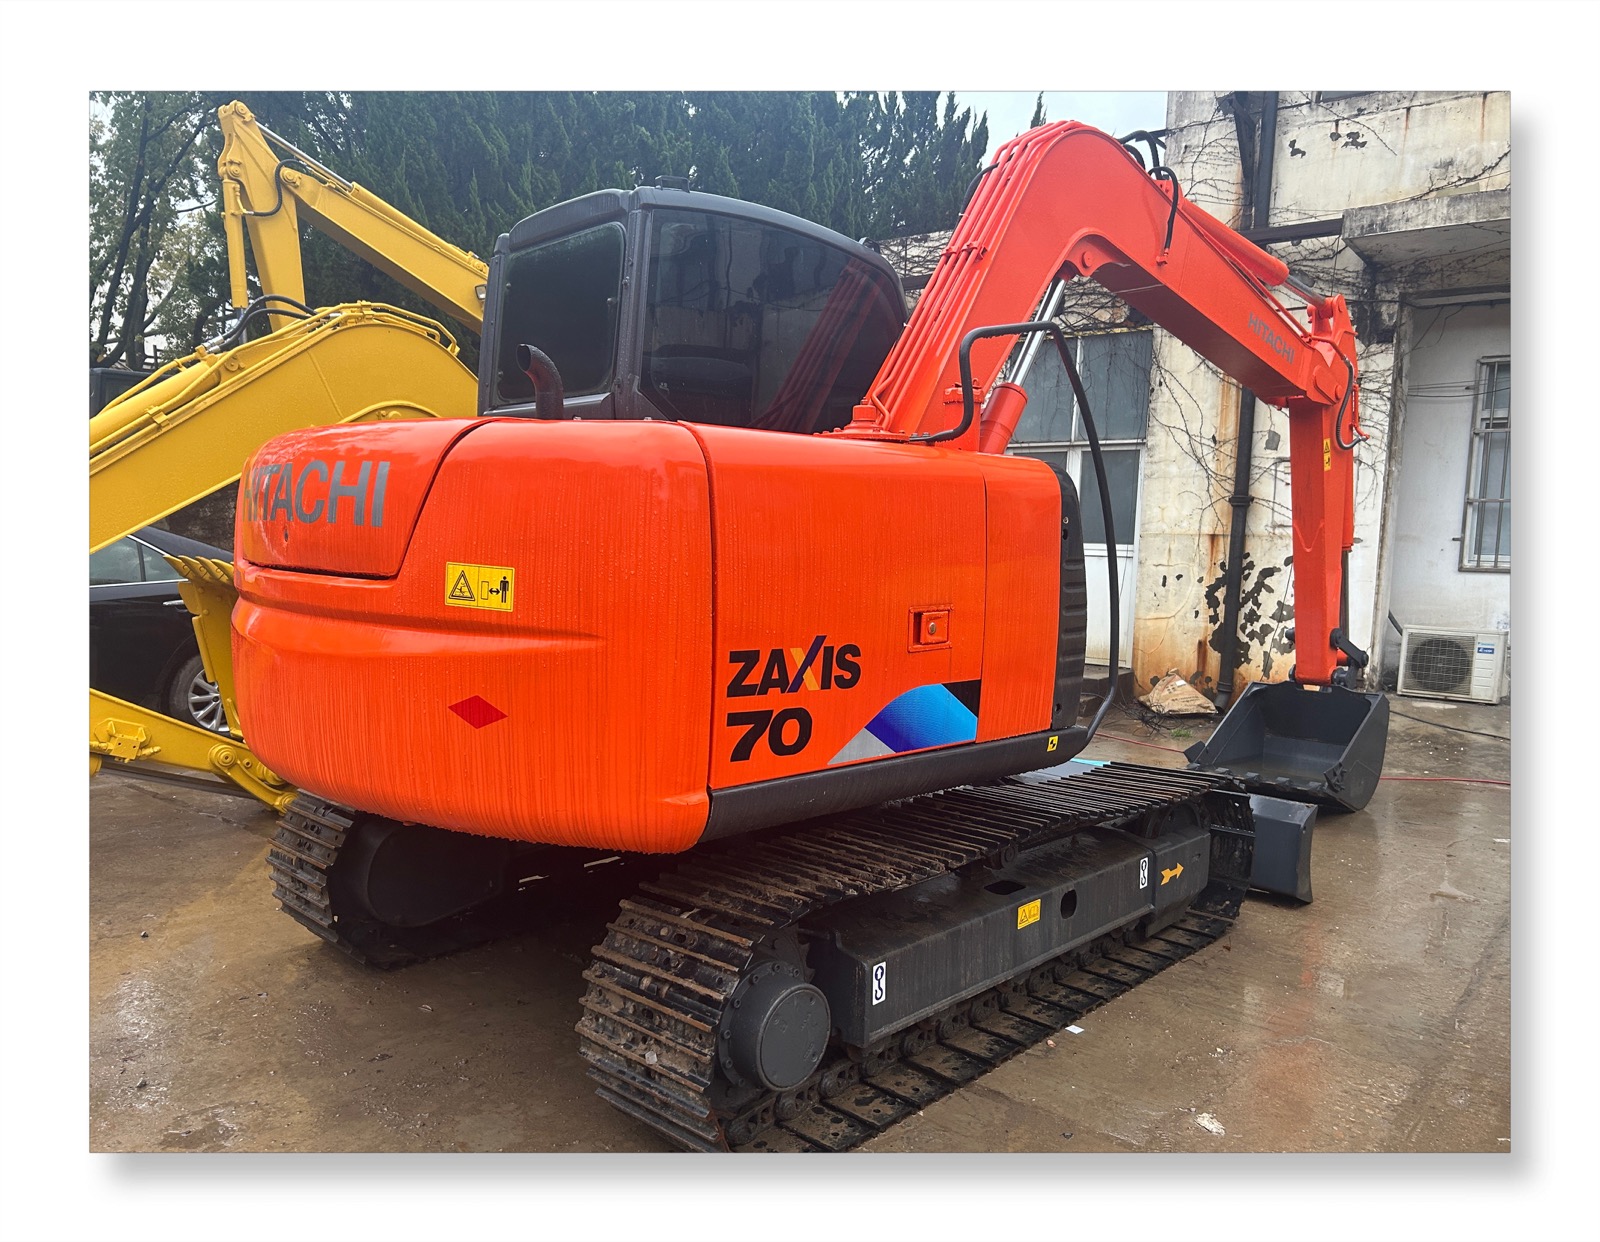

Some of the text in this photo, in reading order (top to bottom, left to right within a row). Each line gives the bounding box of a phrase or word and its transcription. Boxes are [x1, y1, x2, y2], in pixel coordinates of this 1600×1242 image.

[1248, 311, 1295, 365] HITACHI
[243, 459, 391, 528] HITACHI
[726, 634, 862, 698] ZAXIS
[726, 706, 813, 763] 70
